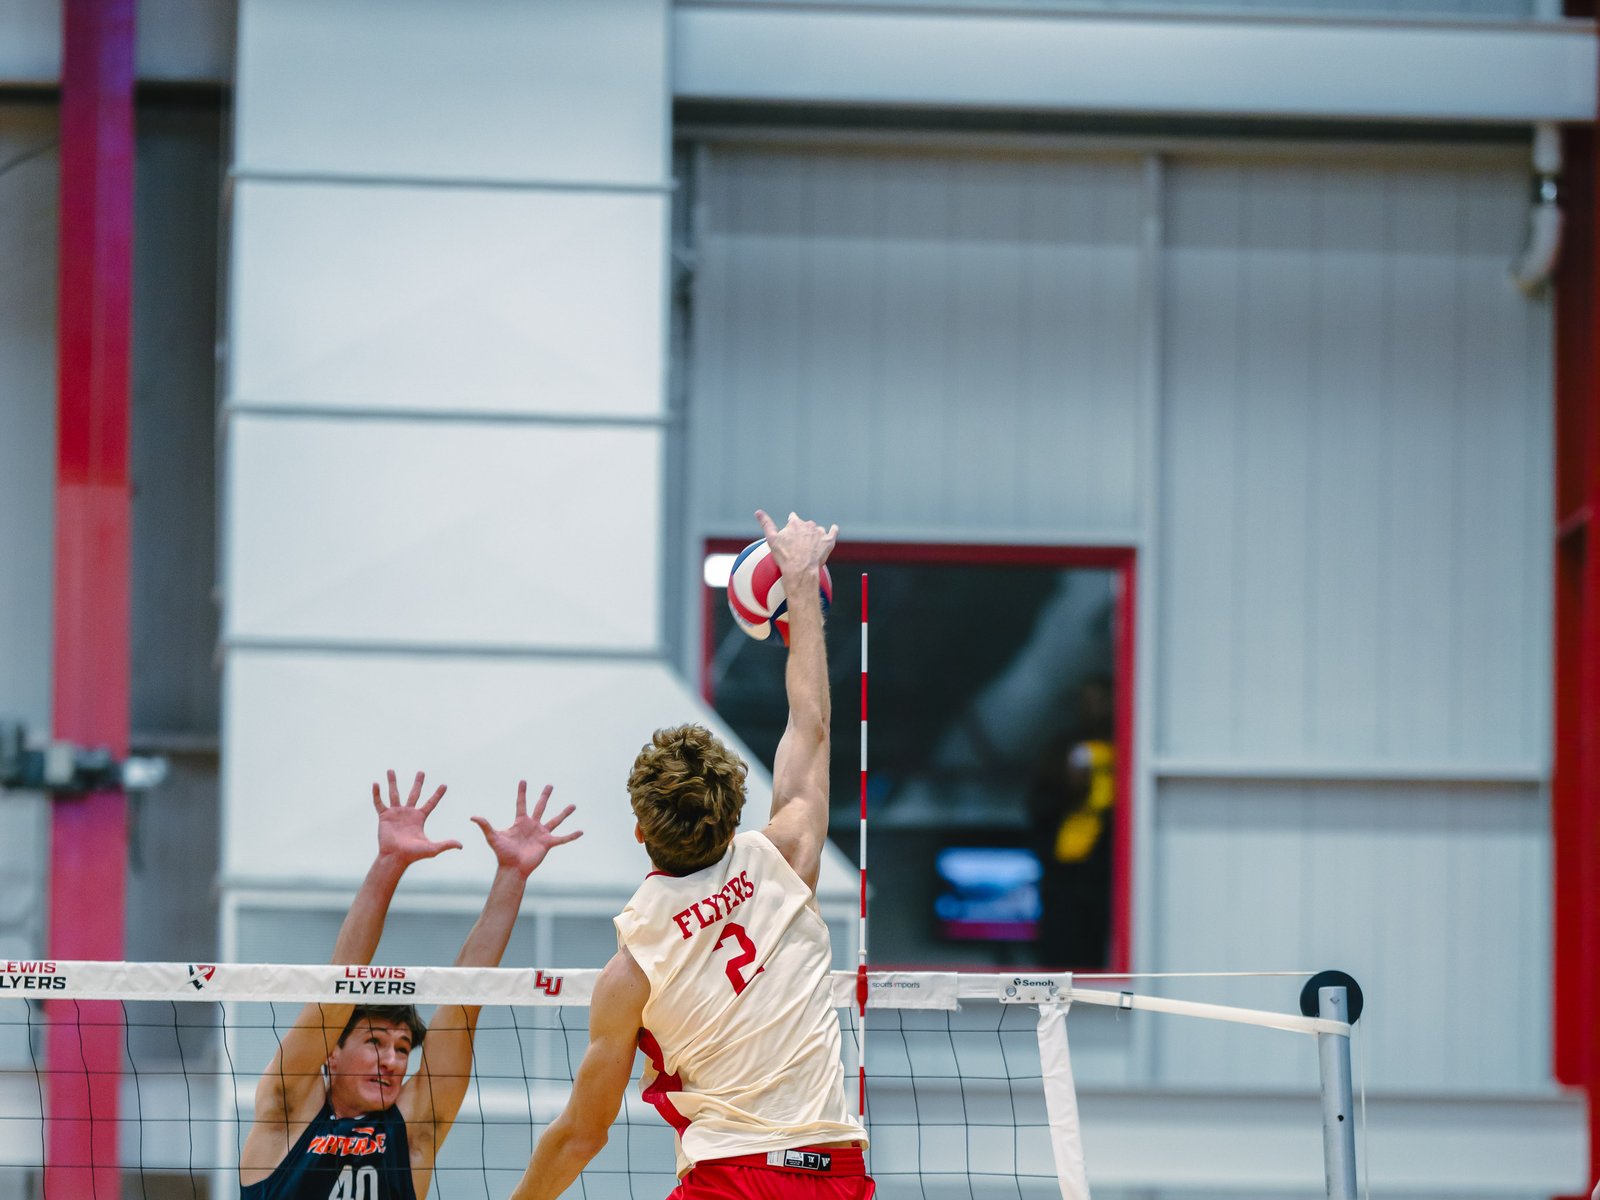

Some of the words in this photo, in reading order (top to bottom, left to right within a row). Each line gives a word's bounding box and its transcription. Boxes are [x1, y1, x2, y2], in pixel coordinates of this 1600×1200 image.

[672, 870, 754, 940] FLYERS
[712, 922, 765, 996] 2
[345, 966, 406, 979] LEWIS
[335, 980, 416, 995] FLYERS
[1022, 979, 1054, 987] Senoh
